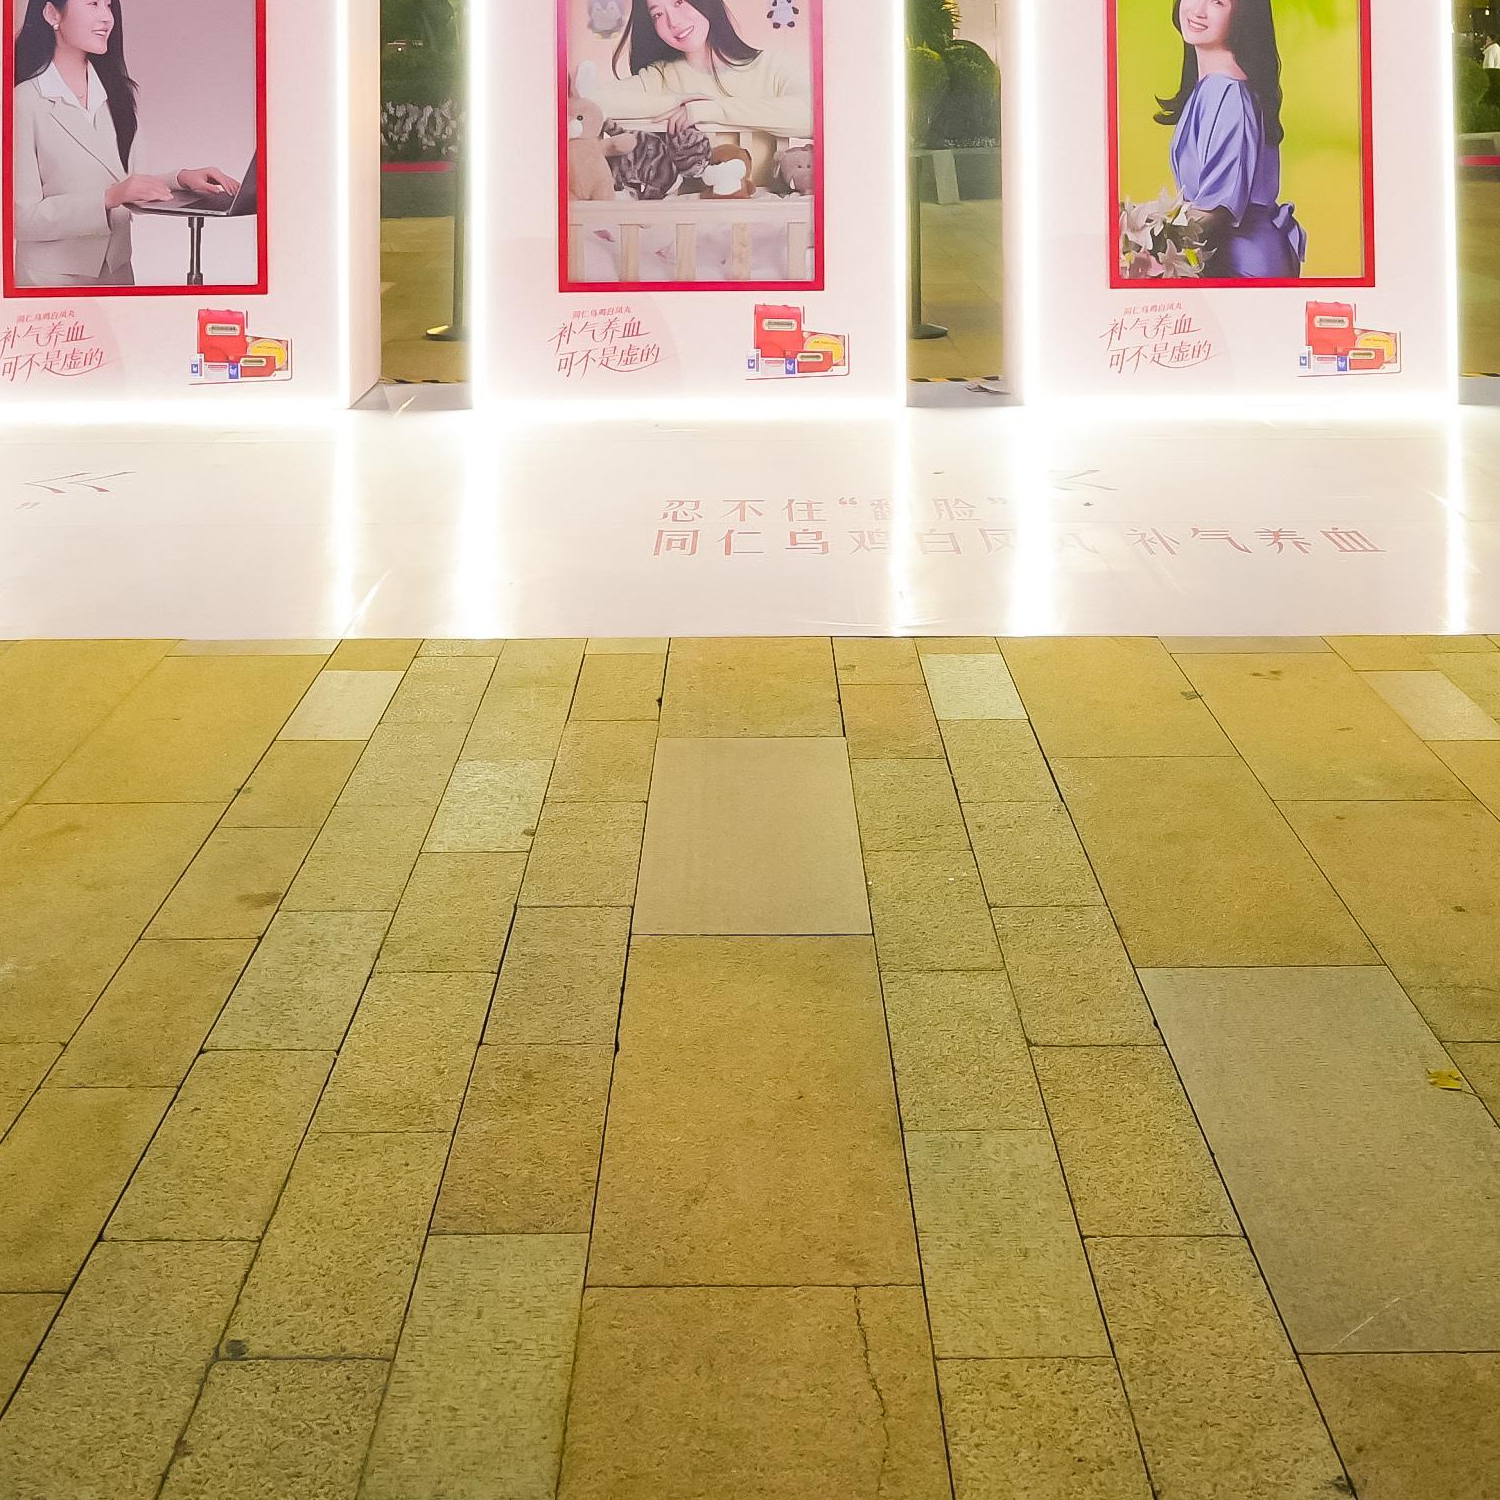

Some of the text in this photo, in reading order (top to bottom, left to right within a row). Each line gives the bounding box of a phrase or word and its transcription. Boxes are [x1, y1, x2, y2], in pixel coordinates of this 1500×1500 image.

[548, 316, 651, 353] 补气养血
[1099, 313, 1204, 350] 补气养血
[0, 348, 104, 384] 可不是虚的
[557, 344, 661, 380] 可不是虚的
[1108, 340, 1212, 375] 可不是虚的
[1125, 526, 1387, 556] 补气养血
